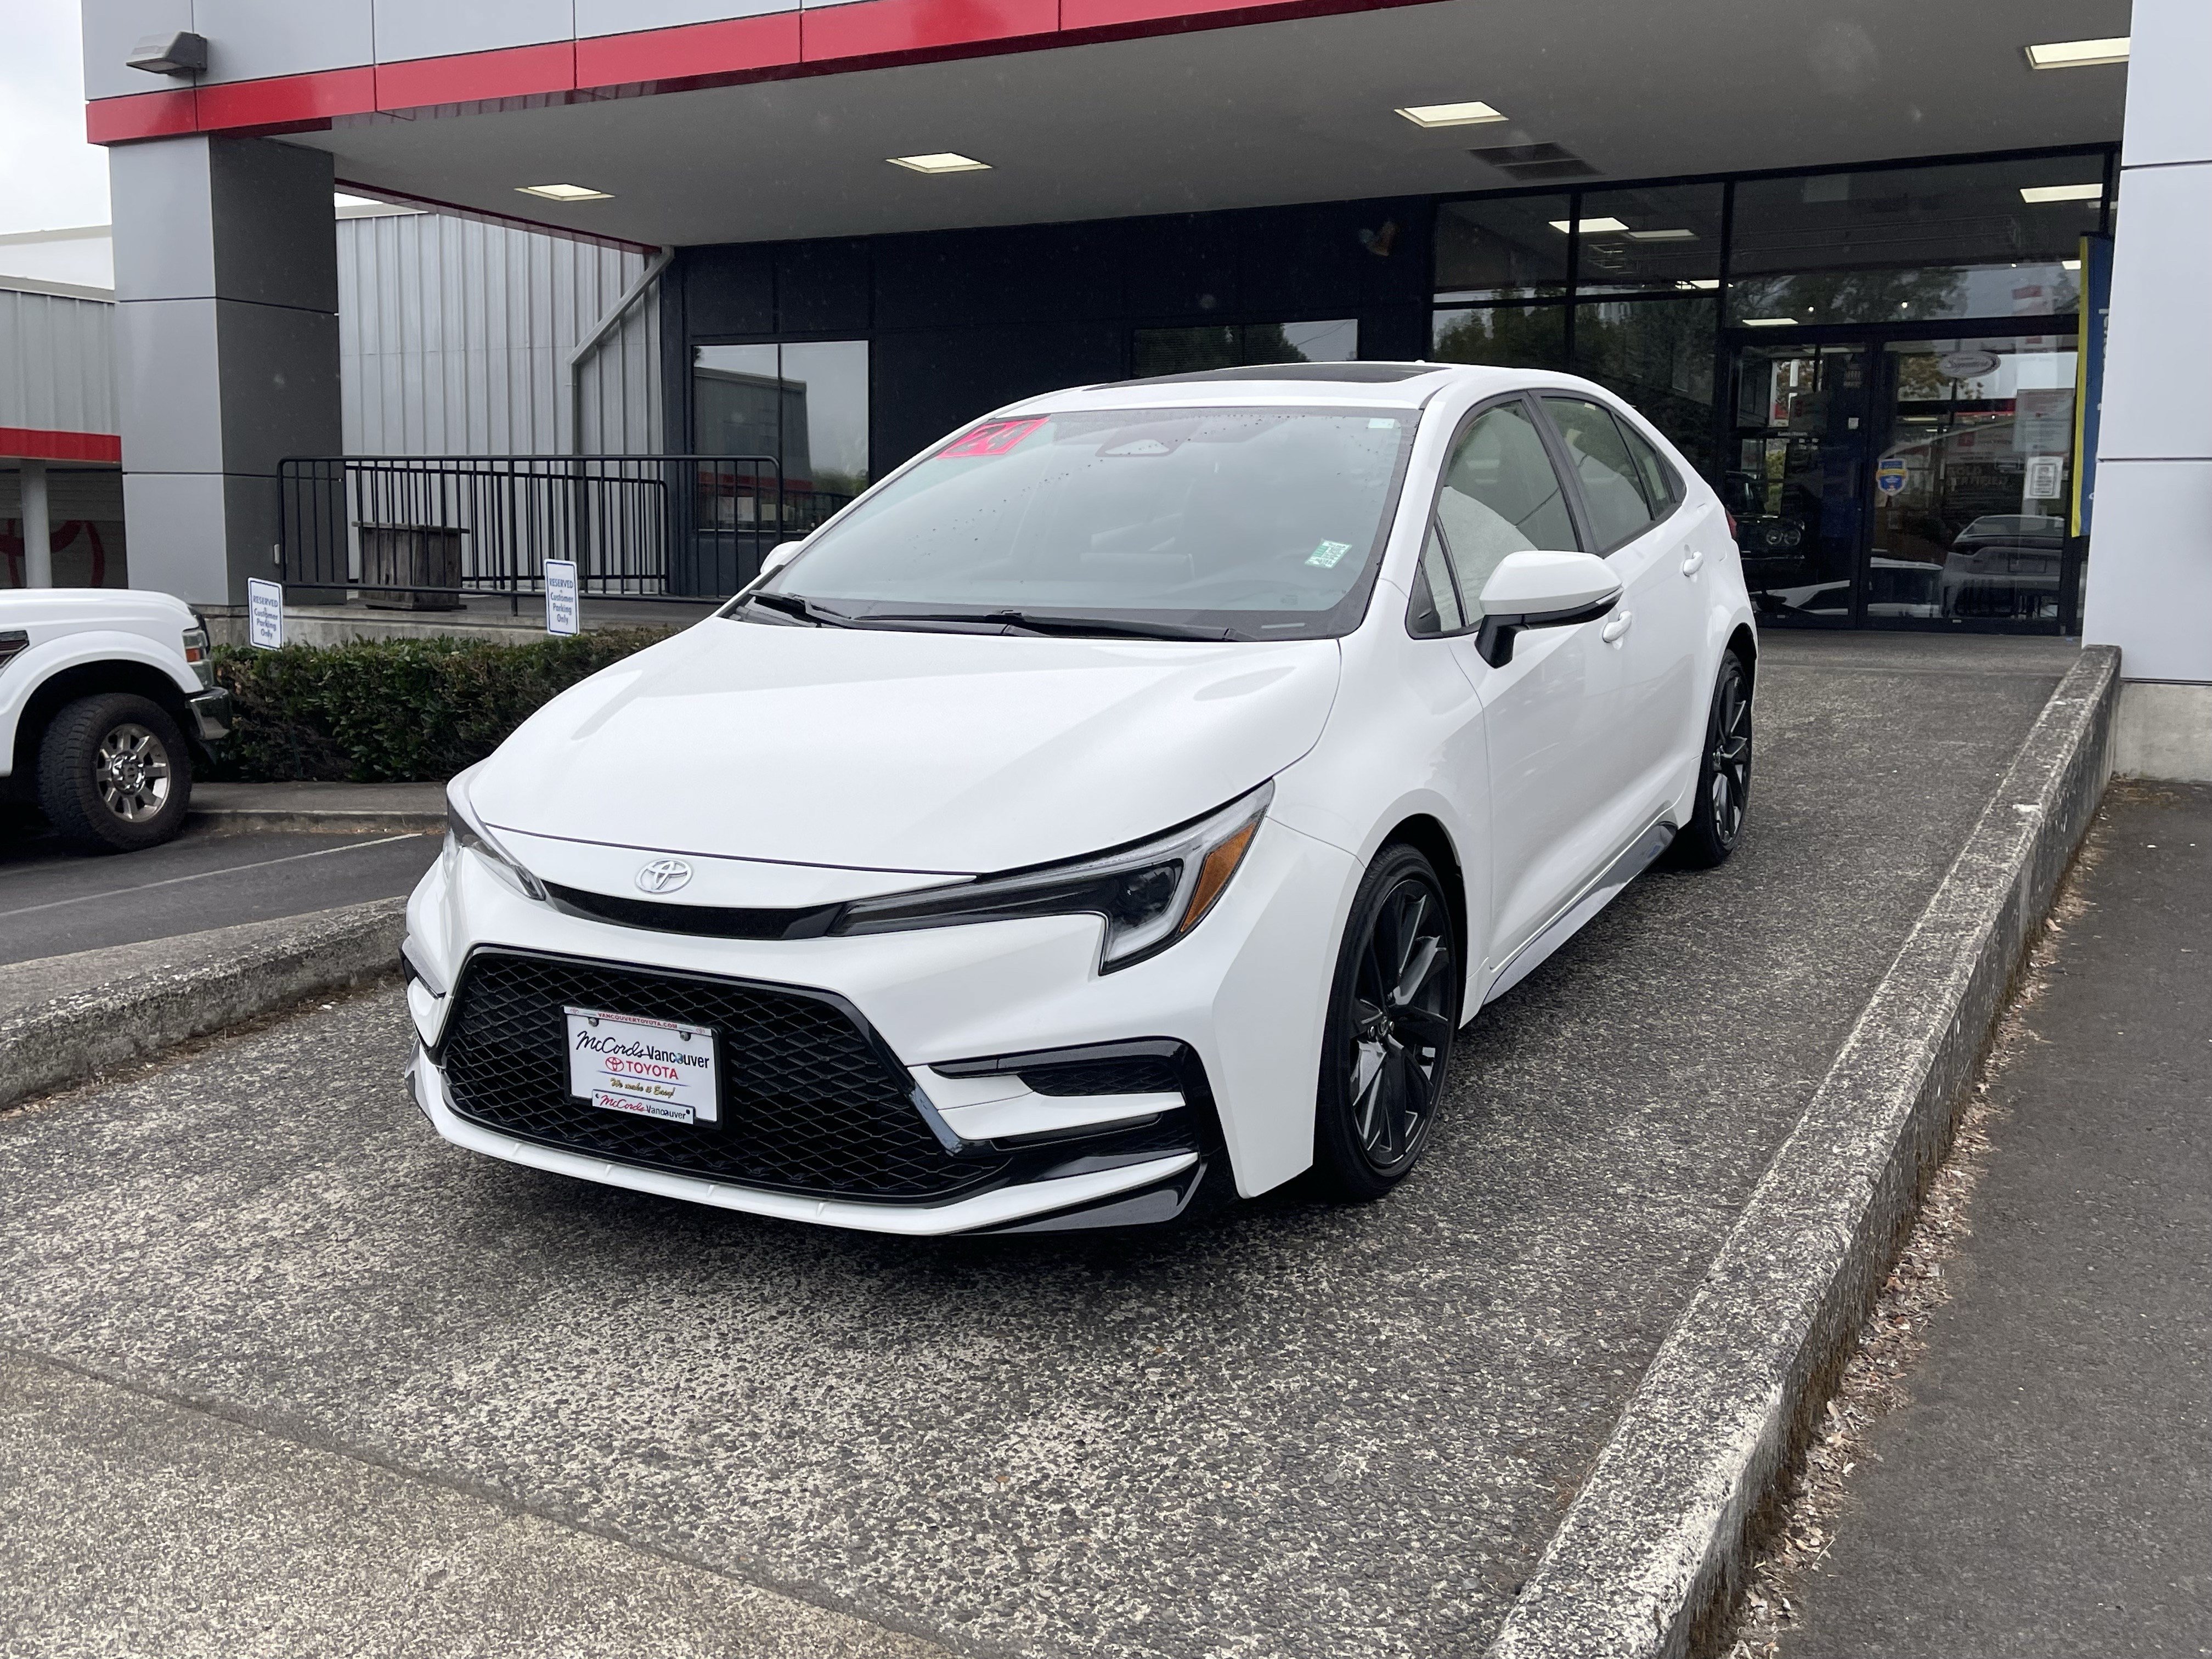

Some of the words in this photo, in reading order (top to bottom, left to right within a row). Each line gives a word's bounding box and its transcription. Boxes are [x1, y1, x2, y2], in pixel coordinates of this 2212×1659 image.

[549, 578, 573, 589] RESERVED
[253, 595, 278, 607] RESERVED
[550, 592, 573, 602] Customer
[254, 607, 278, 620] Customer
[553, 603, 572, 615] Parking
[256, 618, 276, 631] Parking
[557, 613, 568, 625] Only
[261, 628, 272, 640] Only
[597, 1012, 678, 1029] VANCOUVERTOYOTA.COM
[626, 1060, 679, 1080] TOYOTA
